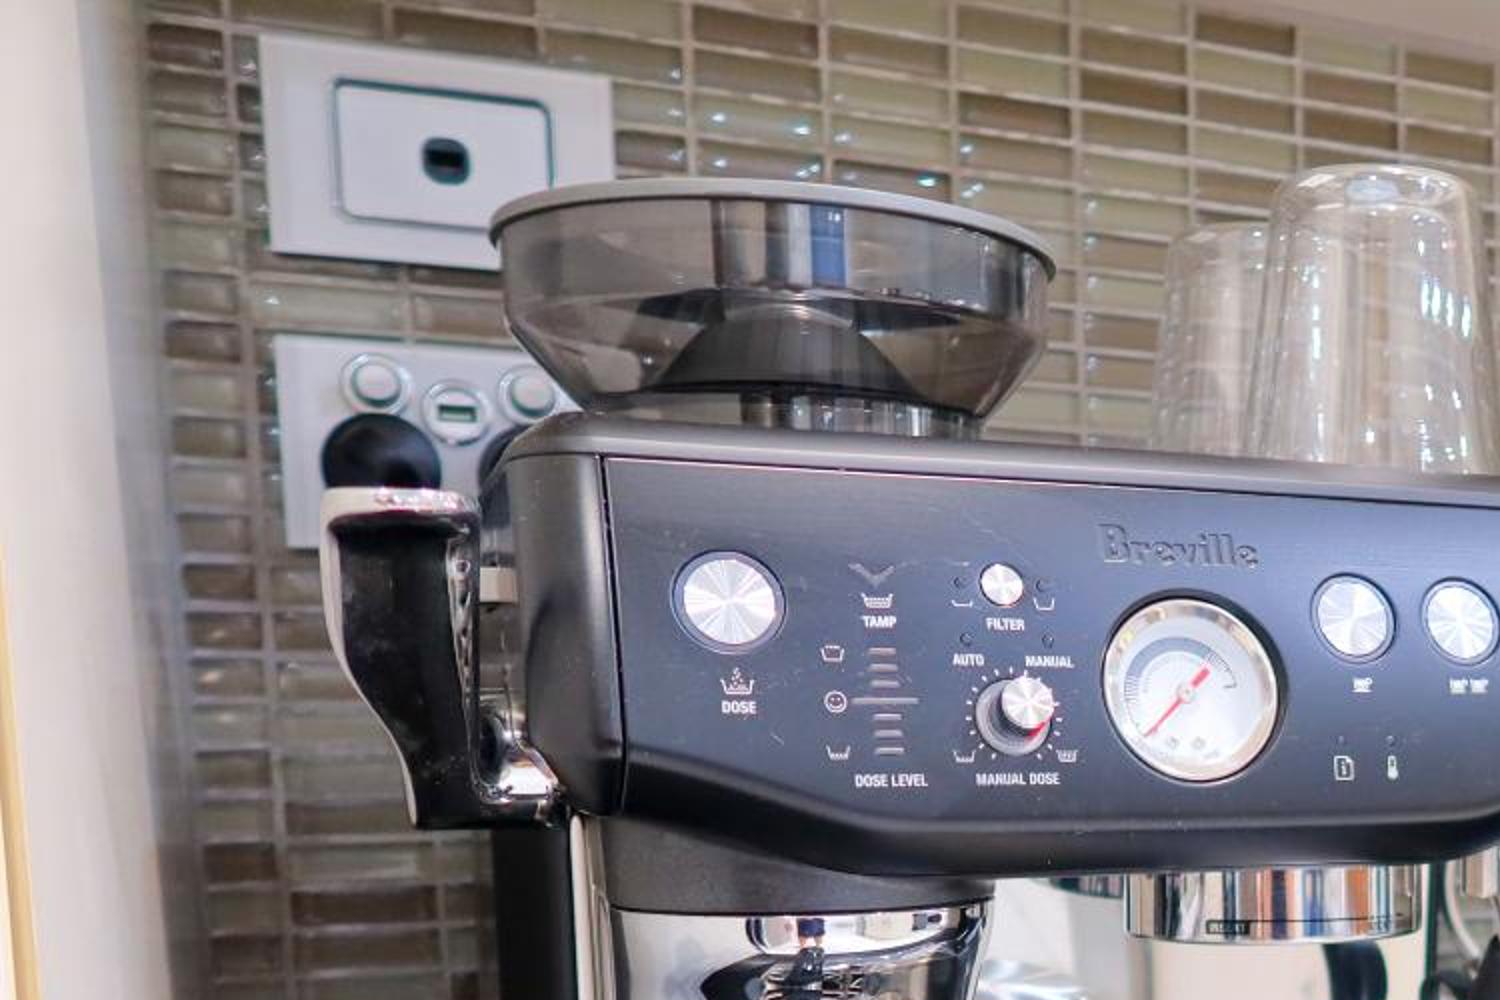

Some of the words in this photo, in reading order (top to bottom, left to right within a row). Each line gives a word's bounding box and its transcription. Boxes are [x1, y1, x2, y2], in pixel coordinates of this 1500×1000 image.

[1098, 523, 1258, 570] Breville
[862, 615, 897, 629] TAMP
[985, 617, 1025, 631] FILTER
[953, 653, 985, 667] AUTO
[1025, 655, 1075, 669] MANUAL
[721, 701, 757, 715] DOSE
[854, 774, 889, 788] DOSE
[891, 774, 929, 788] LEVEL
[975, 773, 1027, 786] MANUAL
[1029, 772, 1061, 785] DOSE
